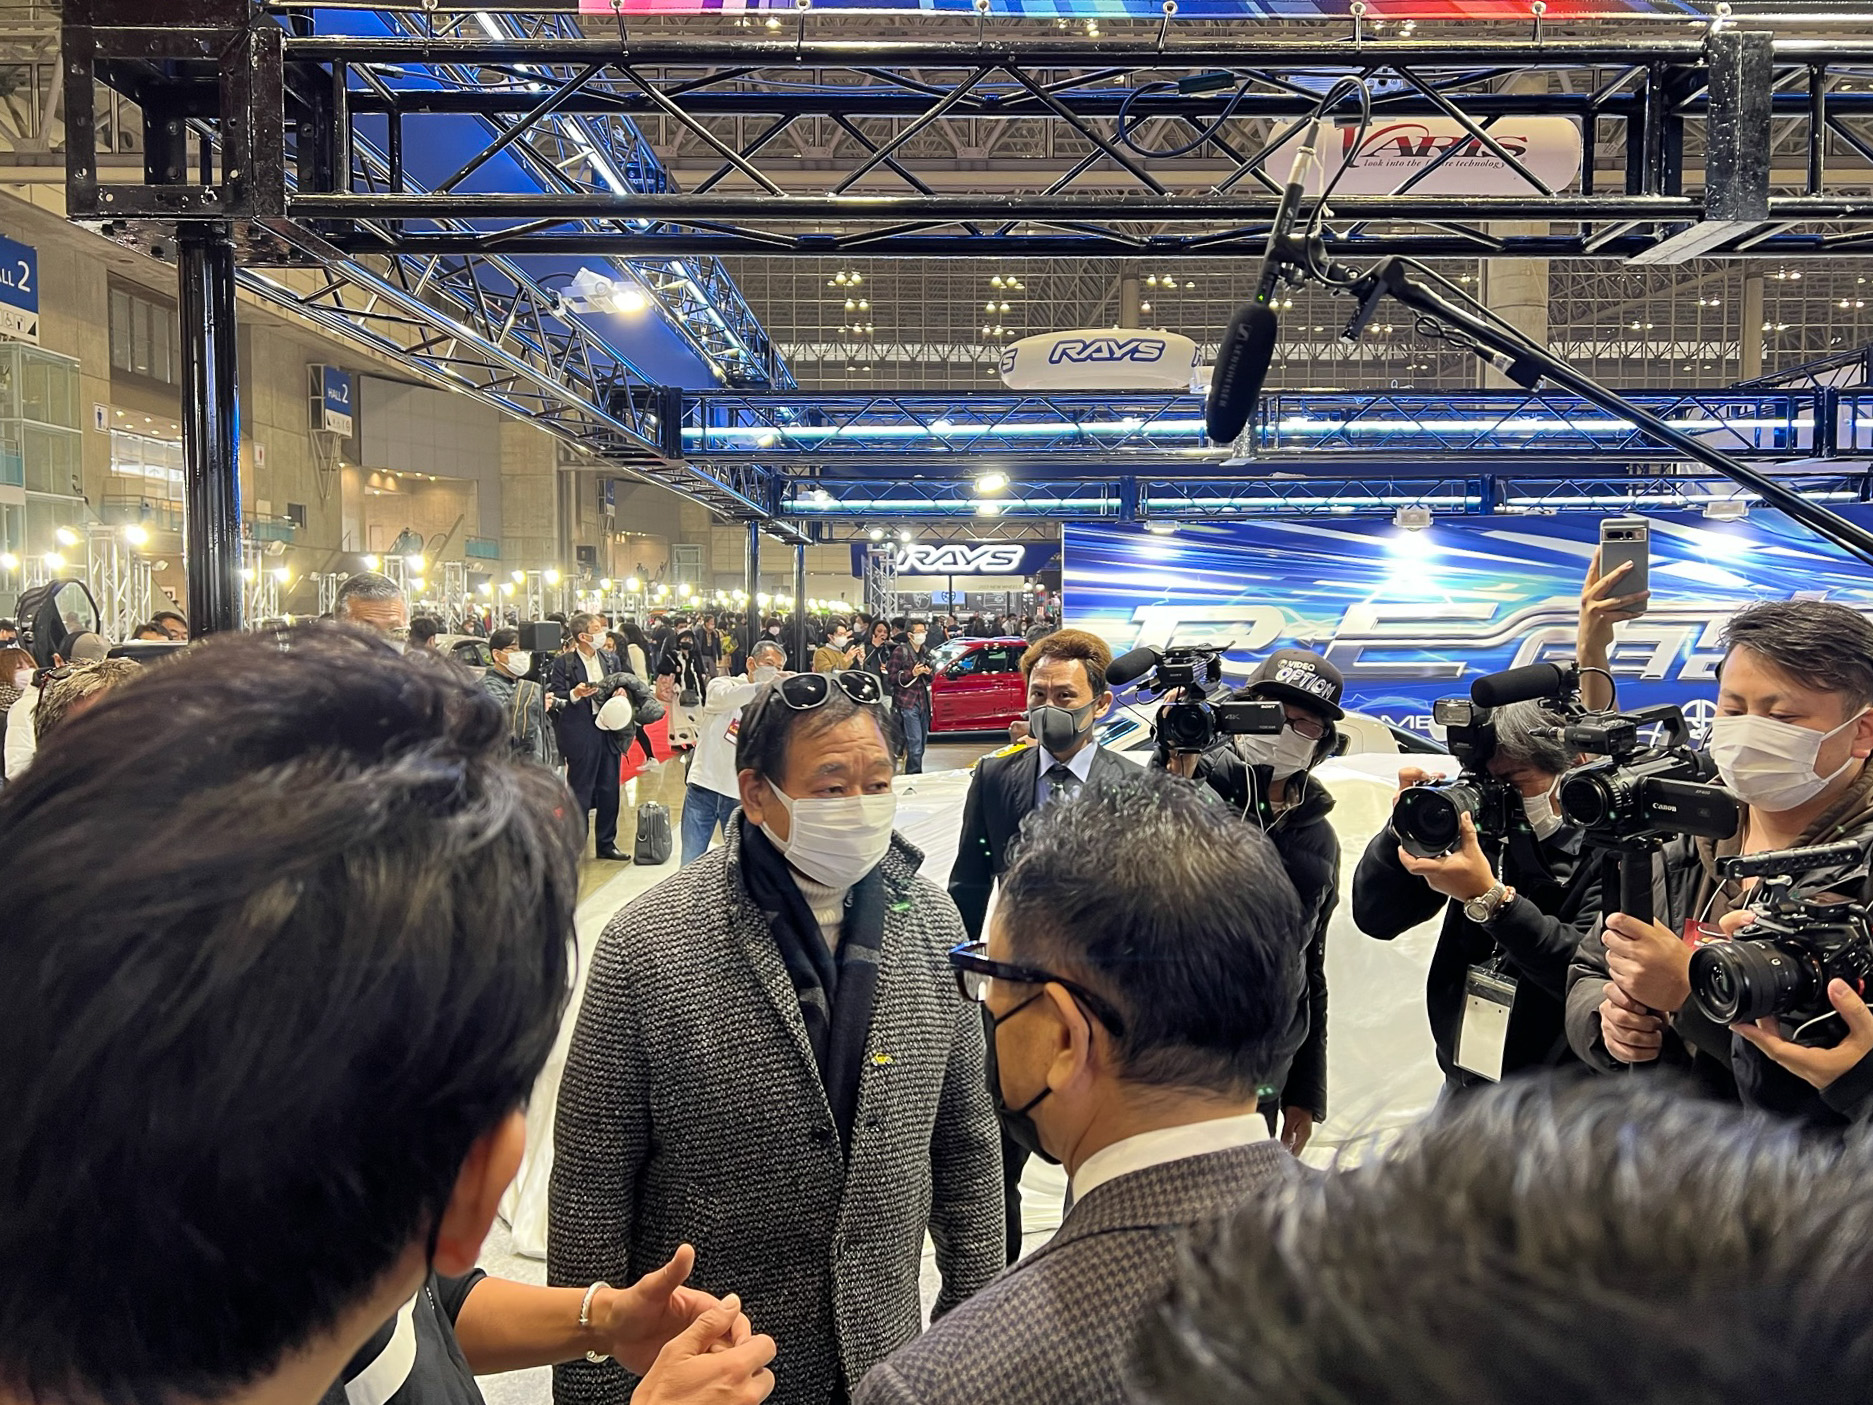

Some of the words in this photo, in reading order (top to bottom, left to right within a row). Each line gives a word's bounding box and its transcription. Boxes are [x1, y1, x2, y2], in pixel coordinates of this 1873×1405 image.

[1337, 124, 1528, 168] VARIS
[1364, 159, 1383, 167] look
[1386, 159, 1405, 167] into
[1406, 159, 1421, 167] the
[1424, 159, 1453, 169] fre
[0, 268, 15, 287] LL
[17, 260, 31, 292] 2
[1048, 338, 1166, 365] RAYS
[328, 387, 341, 402] HALL
[342, 384, 349, 404] 2
[897, 544, 1026, 571] RAYS
[1288, 660, 1315, 672] VIDEO
[1275, 667, 1336, 700] OPTION
[1652, 802, 1677, 812] Canon
